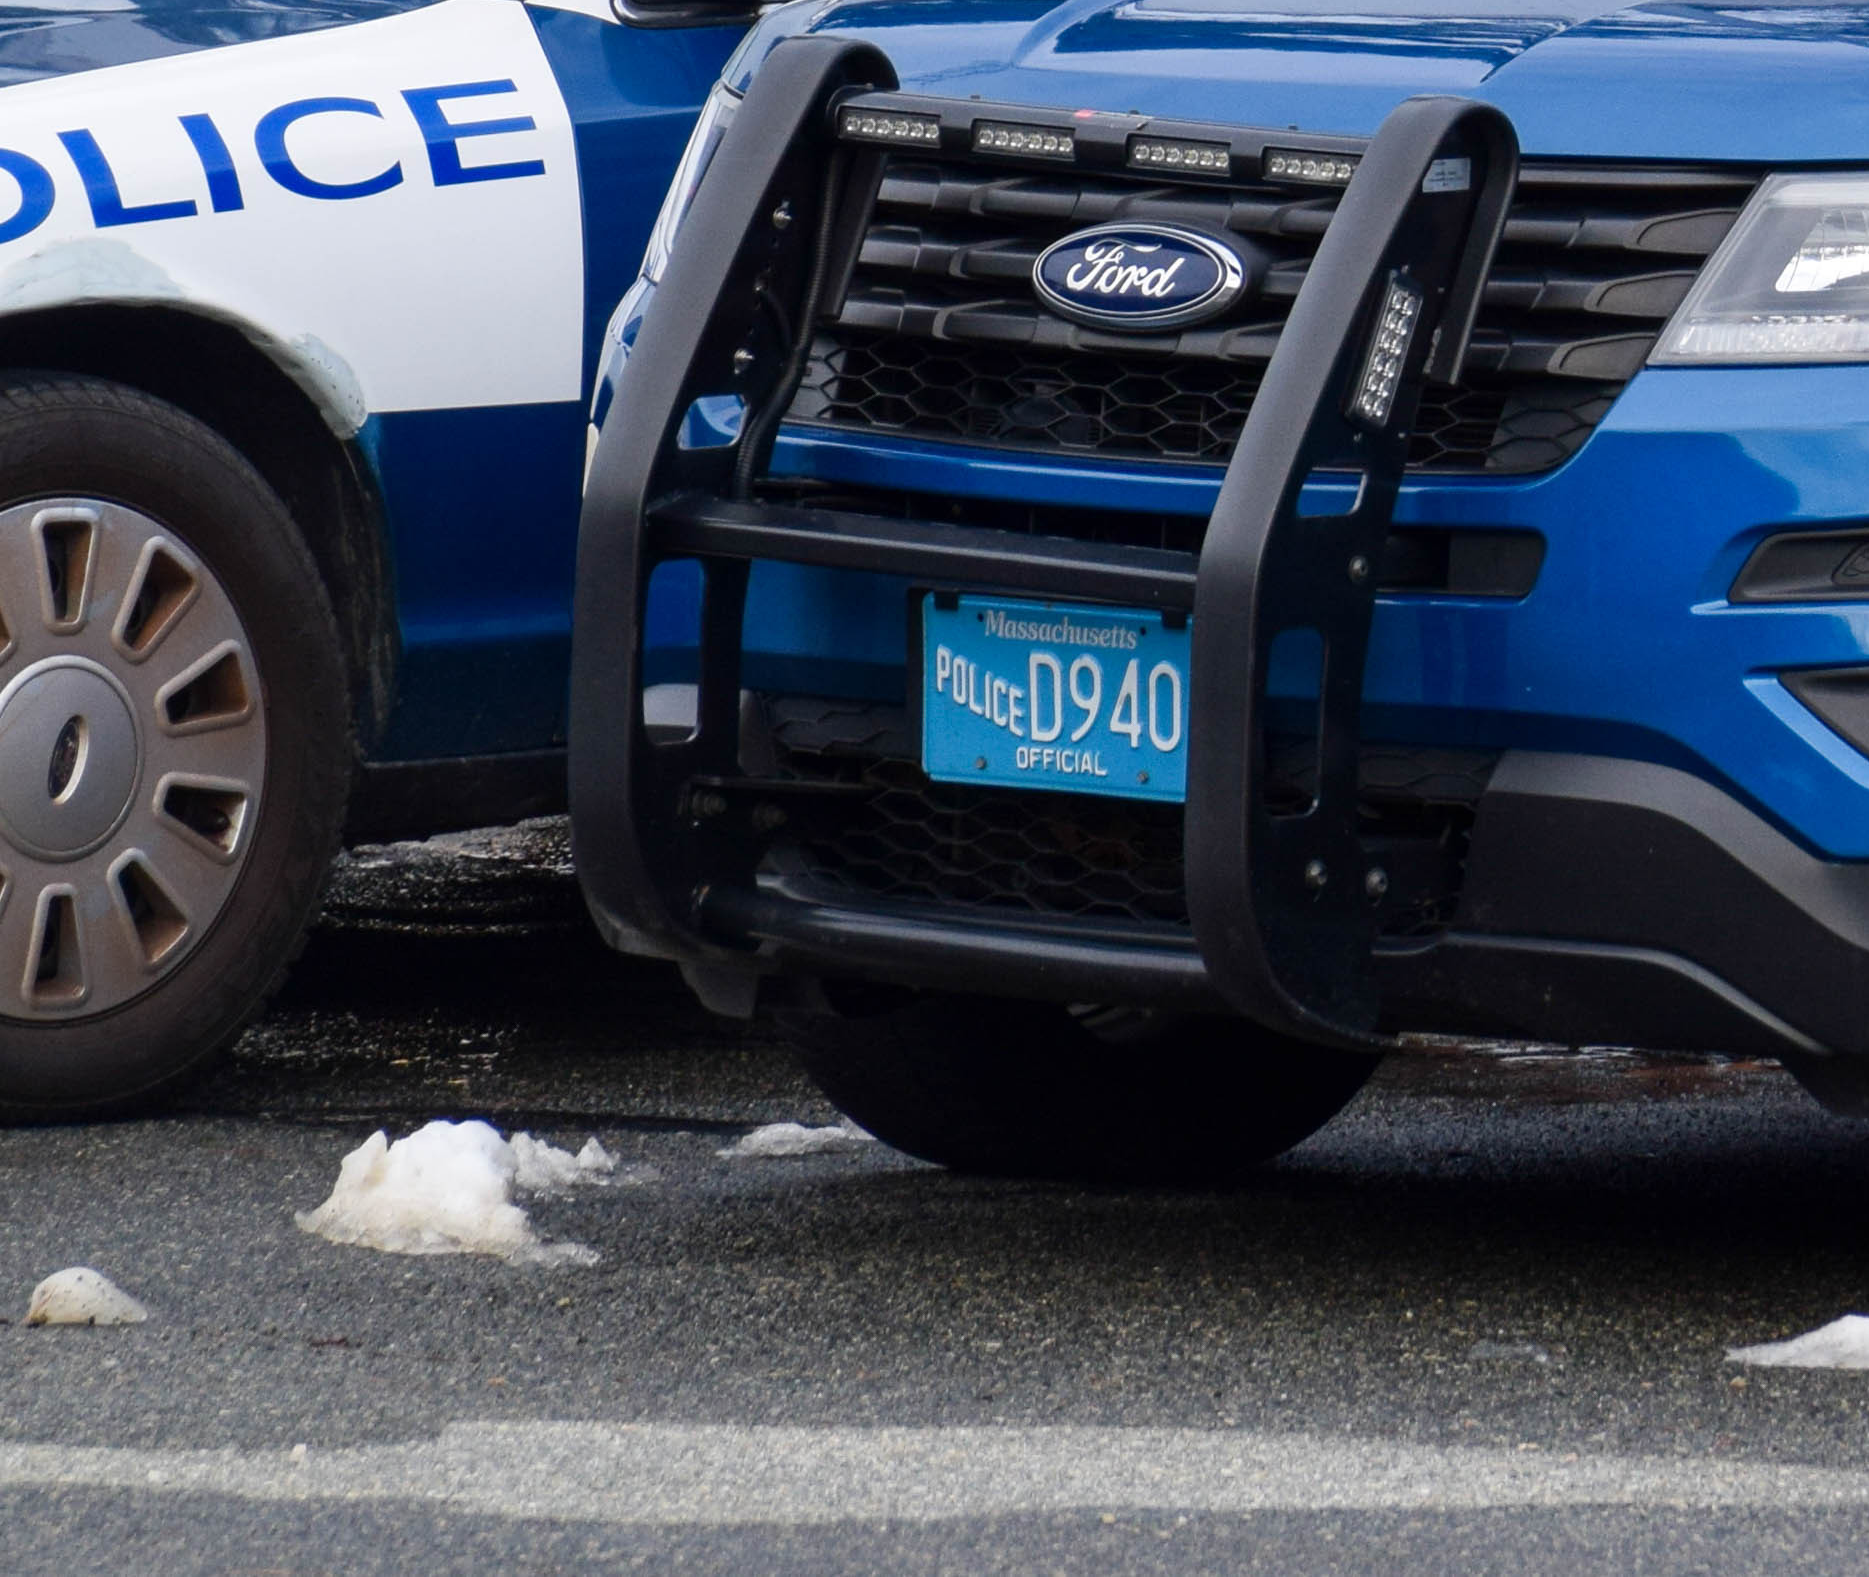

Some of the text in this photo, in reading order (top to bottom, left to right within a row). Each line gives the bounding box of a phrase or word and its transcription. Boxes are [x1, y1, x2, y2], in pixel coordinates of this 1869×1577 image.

[1066, 237, 1186, 298] Ford
[984, 609, 1137, 650] Massachusetts
[936, 643, 1182, 752] POLICE D940
[1016, 746, 1108, 777] OFFICIAL
